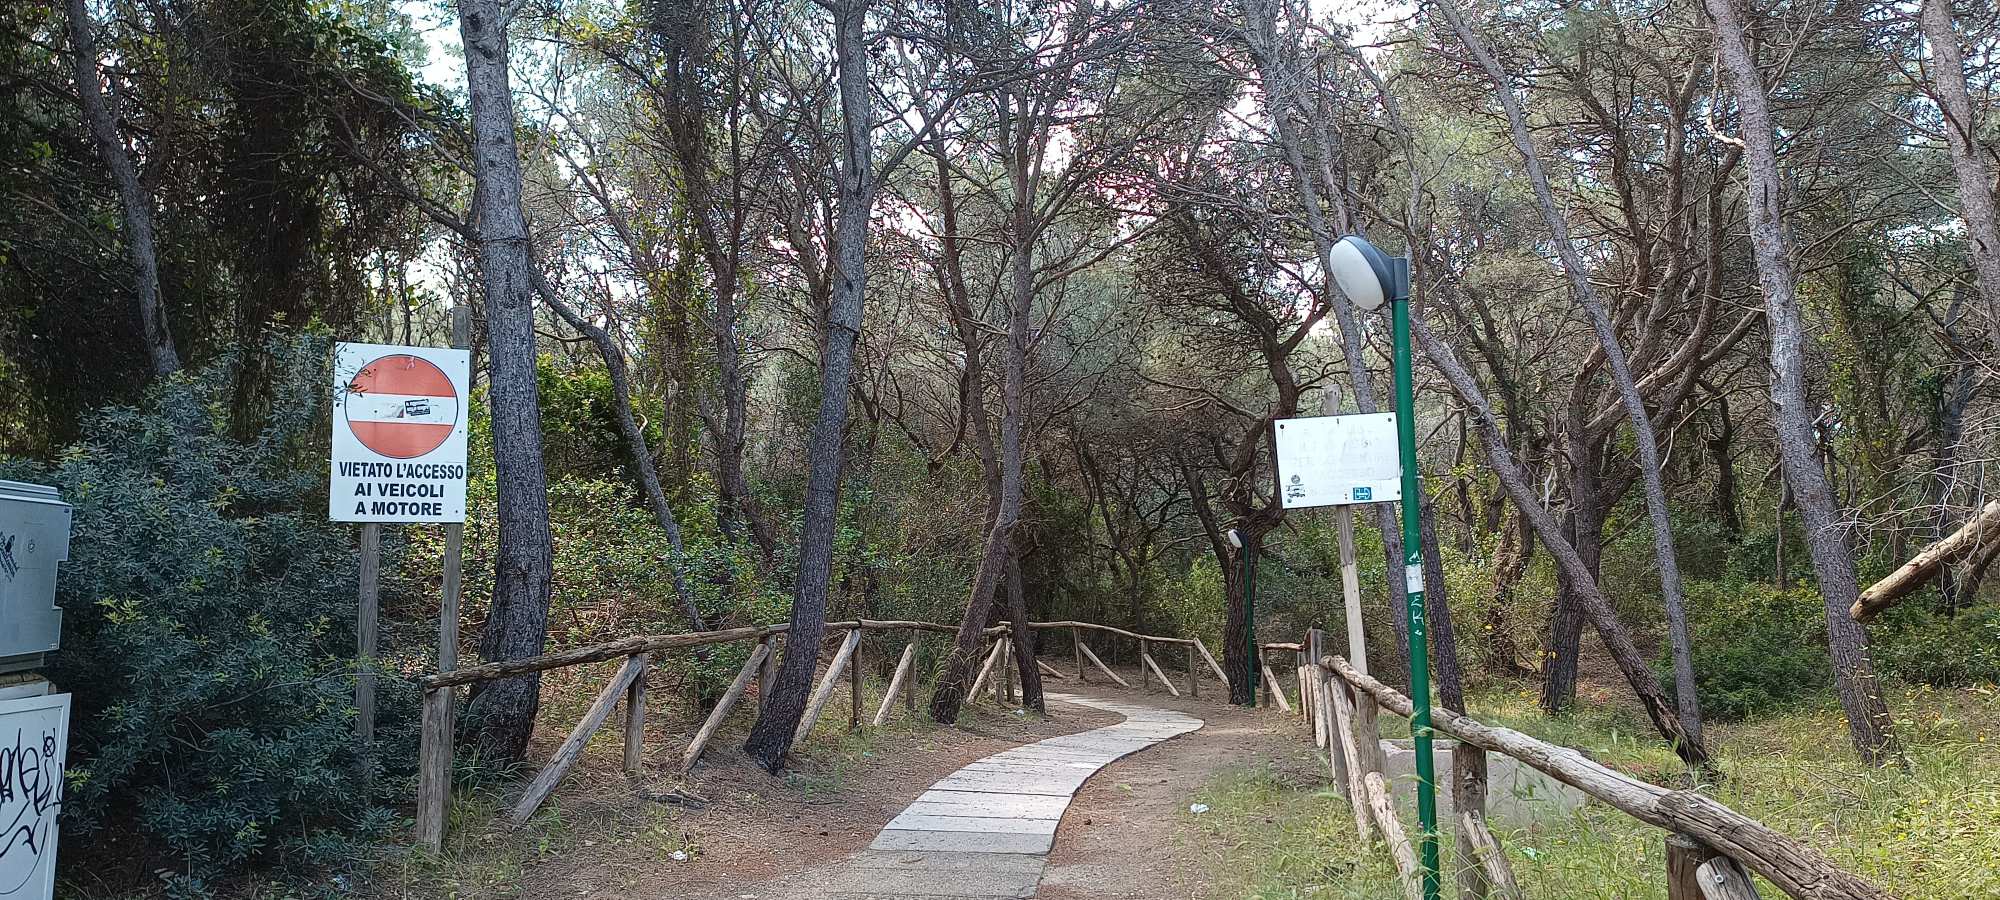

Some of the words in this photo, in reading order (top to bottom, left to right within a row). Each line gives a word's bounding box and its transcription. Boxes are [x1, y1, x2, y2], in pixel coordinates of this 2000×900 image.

[339, 462, 392, 478] VIETATO
[397, 463, 463, 479] L'ACCESSO
[354, 483, 371, 496] AI
[378, 483, 444, 497] VEICOLI
[354, 502, 366, 515] A
[373, 502, 442, 516] MOTORE
